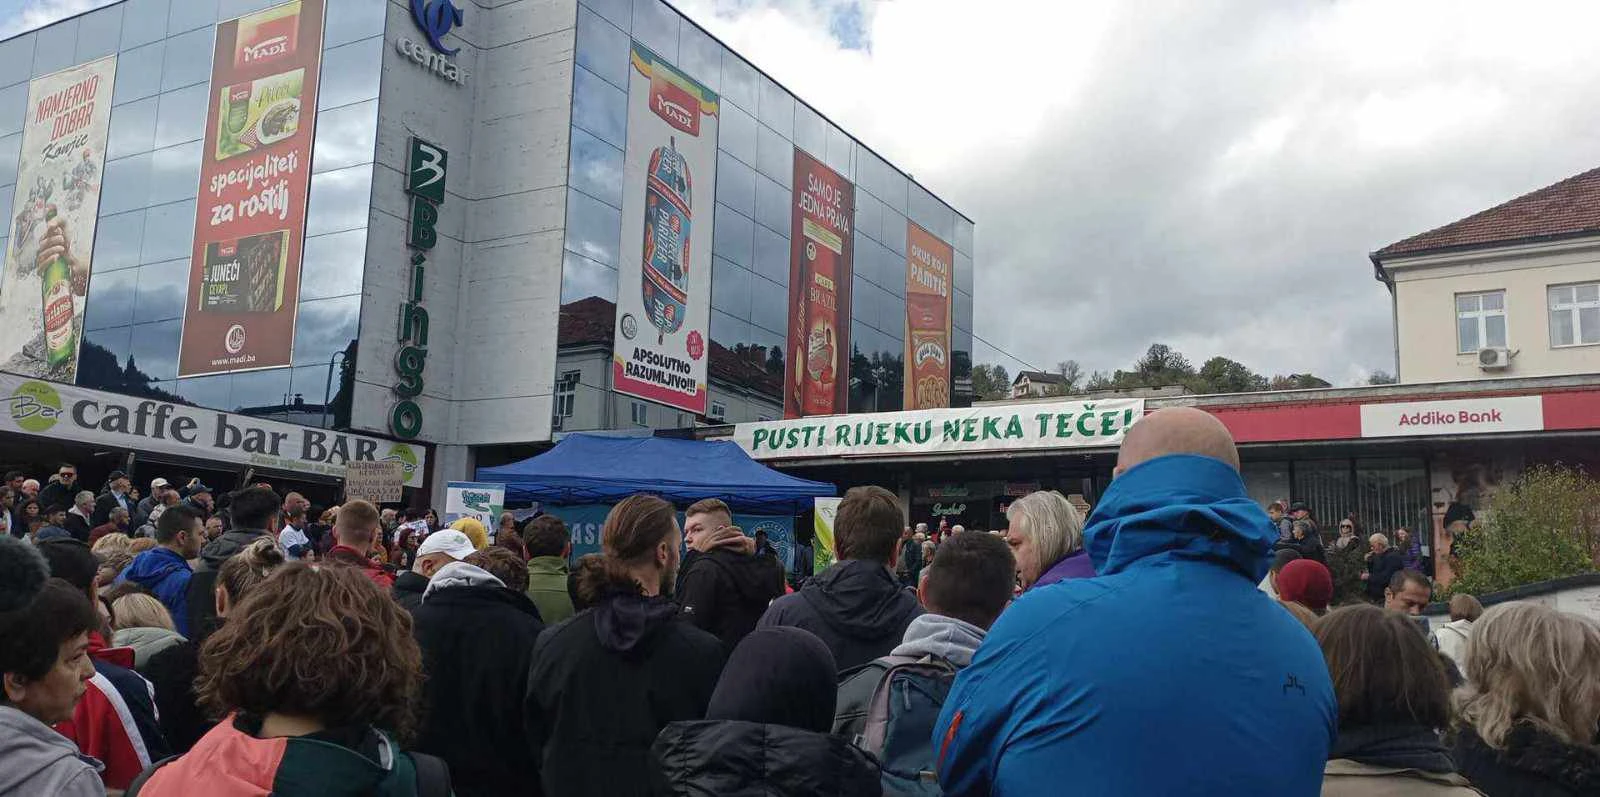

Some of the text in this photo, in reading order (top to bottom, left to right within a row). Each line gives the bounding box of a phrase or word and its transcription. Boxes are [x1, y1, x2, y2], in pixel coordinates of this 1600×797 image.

[243, 36, 288, 62] MADI
[396, 38, 465, 85] centar
[35, 74, 99, 124] NAMJERNO
[656, 94, 692, 128] MADI
[50, 101, 95, 141] DOBAR
[210, 150, 298, 197] specijaliteti
[808, 173, 842, 208] SAMO JE
[210, 179, 289, 225] za roštilj
[798, 190, 849, 234] JEDNA PRAVA
[656, 208, 669, 264] PARIZER
[210, 259, 241, 282] JUNEĆI
[911, 244, 948, 276] OKUS KOJI
[911, 263, 947, 297] PAMTIŠ
[389, 195, 438, 439] Bingo
[211, 354, 256, 366] www.madi.ba
[625, 362, 696, 393] RAZUMLJIVO!!!
[632, 347, 691, 374] APSOLUTNO
[0, 392, 64, 420] Bar
[1398, 409, 1502, 426] Addiko Bank
[72, 400, 378, 465] caffe bar BAR
[752, 404, 1133, 451] PUSTI RIJEKU NEKA TEČE!
